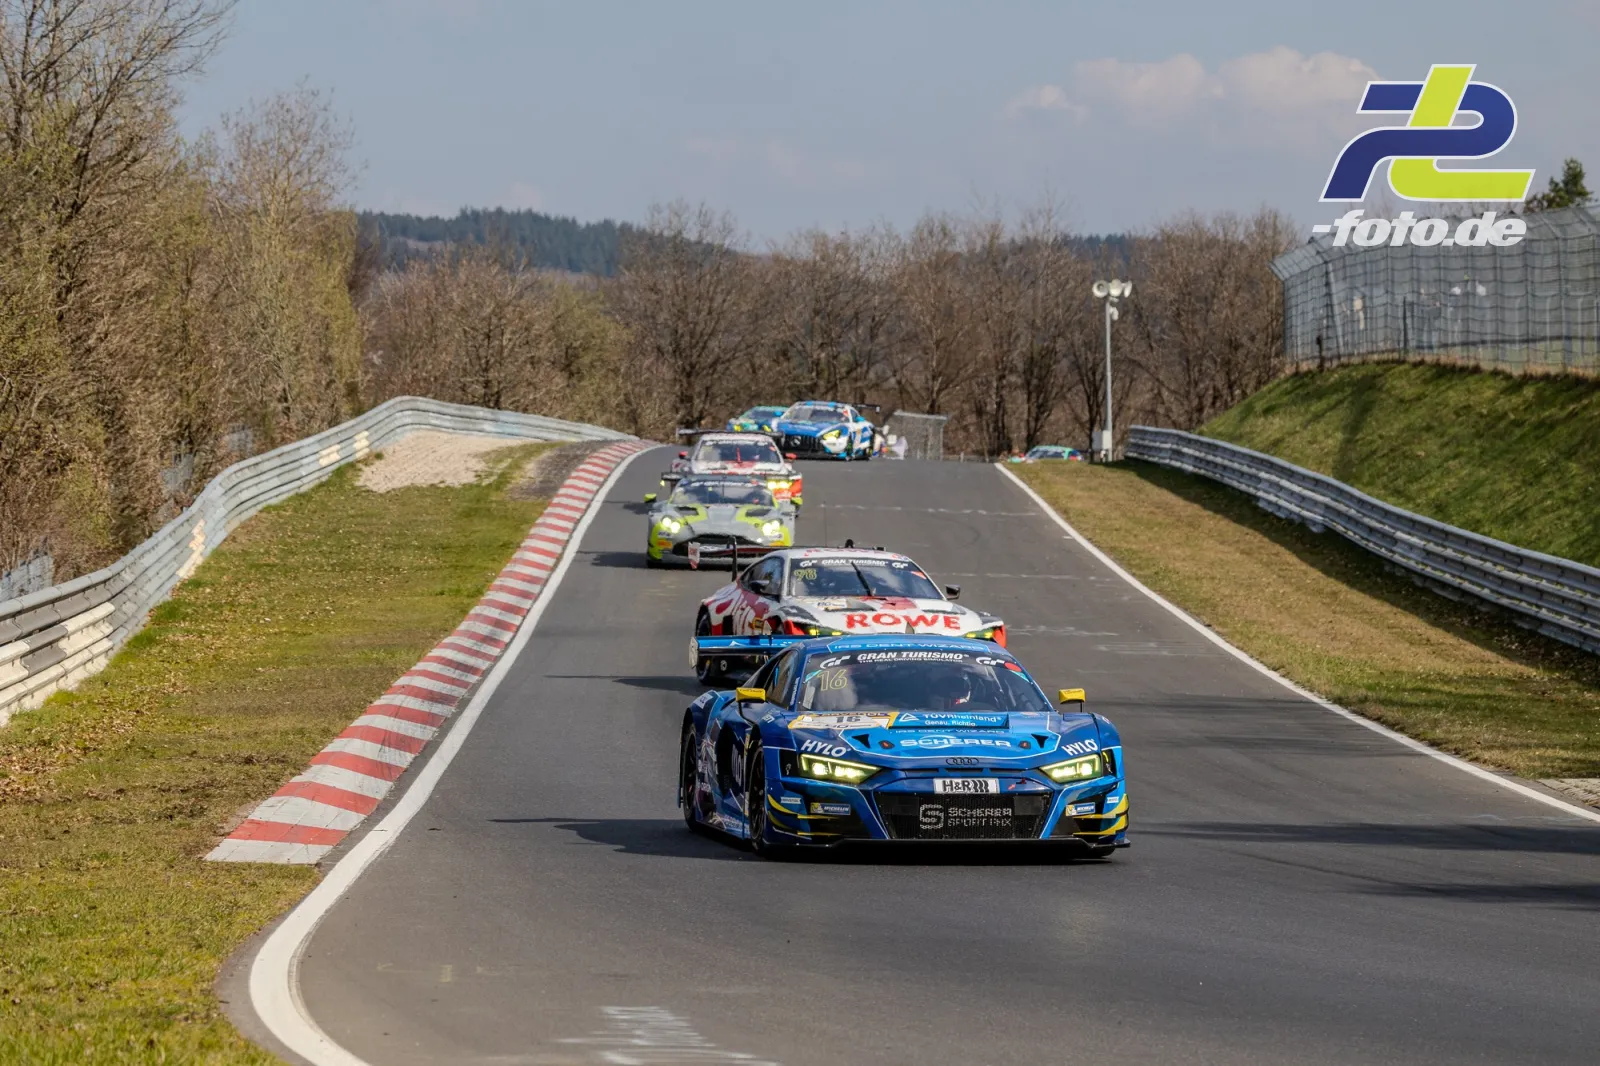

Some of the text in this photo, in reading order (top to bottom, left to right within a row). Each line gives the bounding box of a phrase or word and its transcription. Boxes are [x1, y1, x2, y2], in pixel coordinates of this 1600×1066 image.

[846, 613, 961, 629] ROWE
[857, 651, 964, 661] GRAN TURISMO
[817, 669, 848, 692] 16
[800, 739, 847, 758] HYLO
[900, 738, 1011, 748] SCHERER
[1061, 739, 1098, 756] HYLO
[942, 779, 972, 792] H&R
